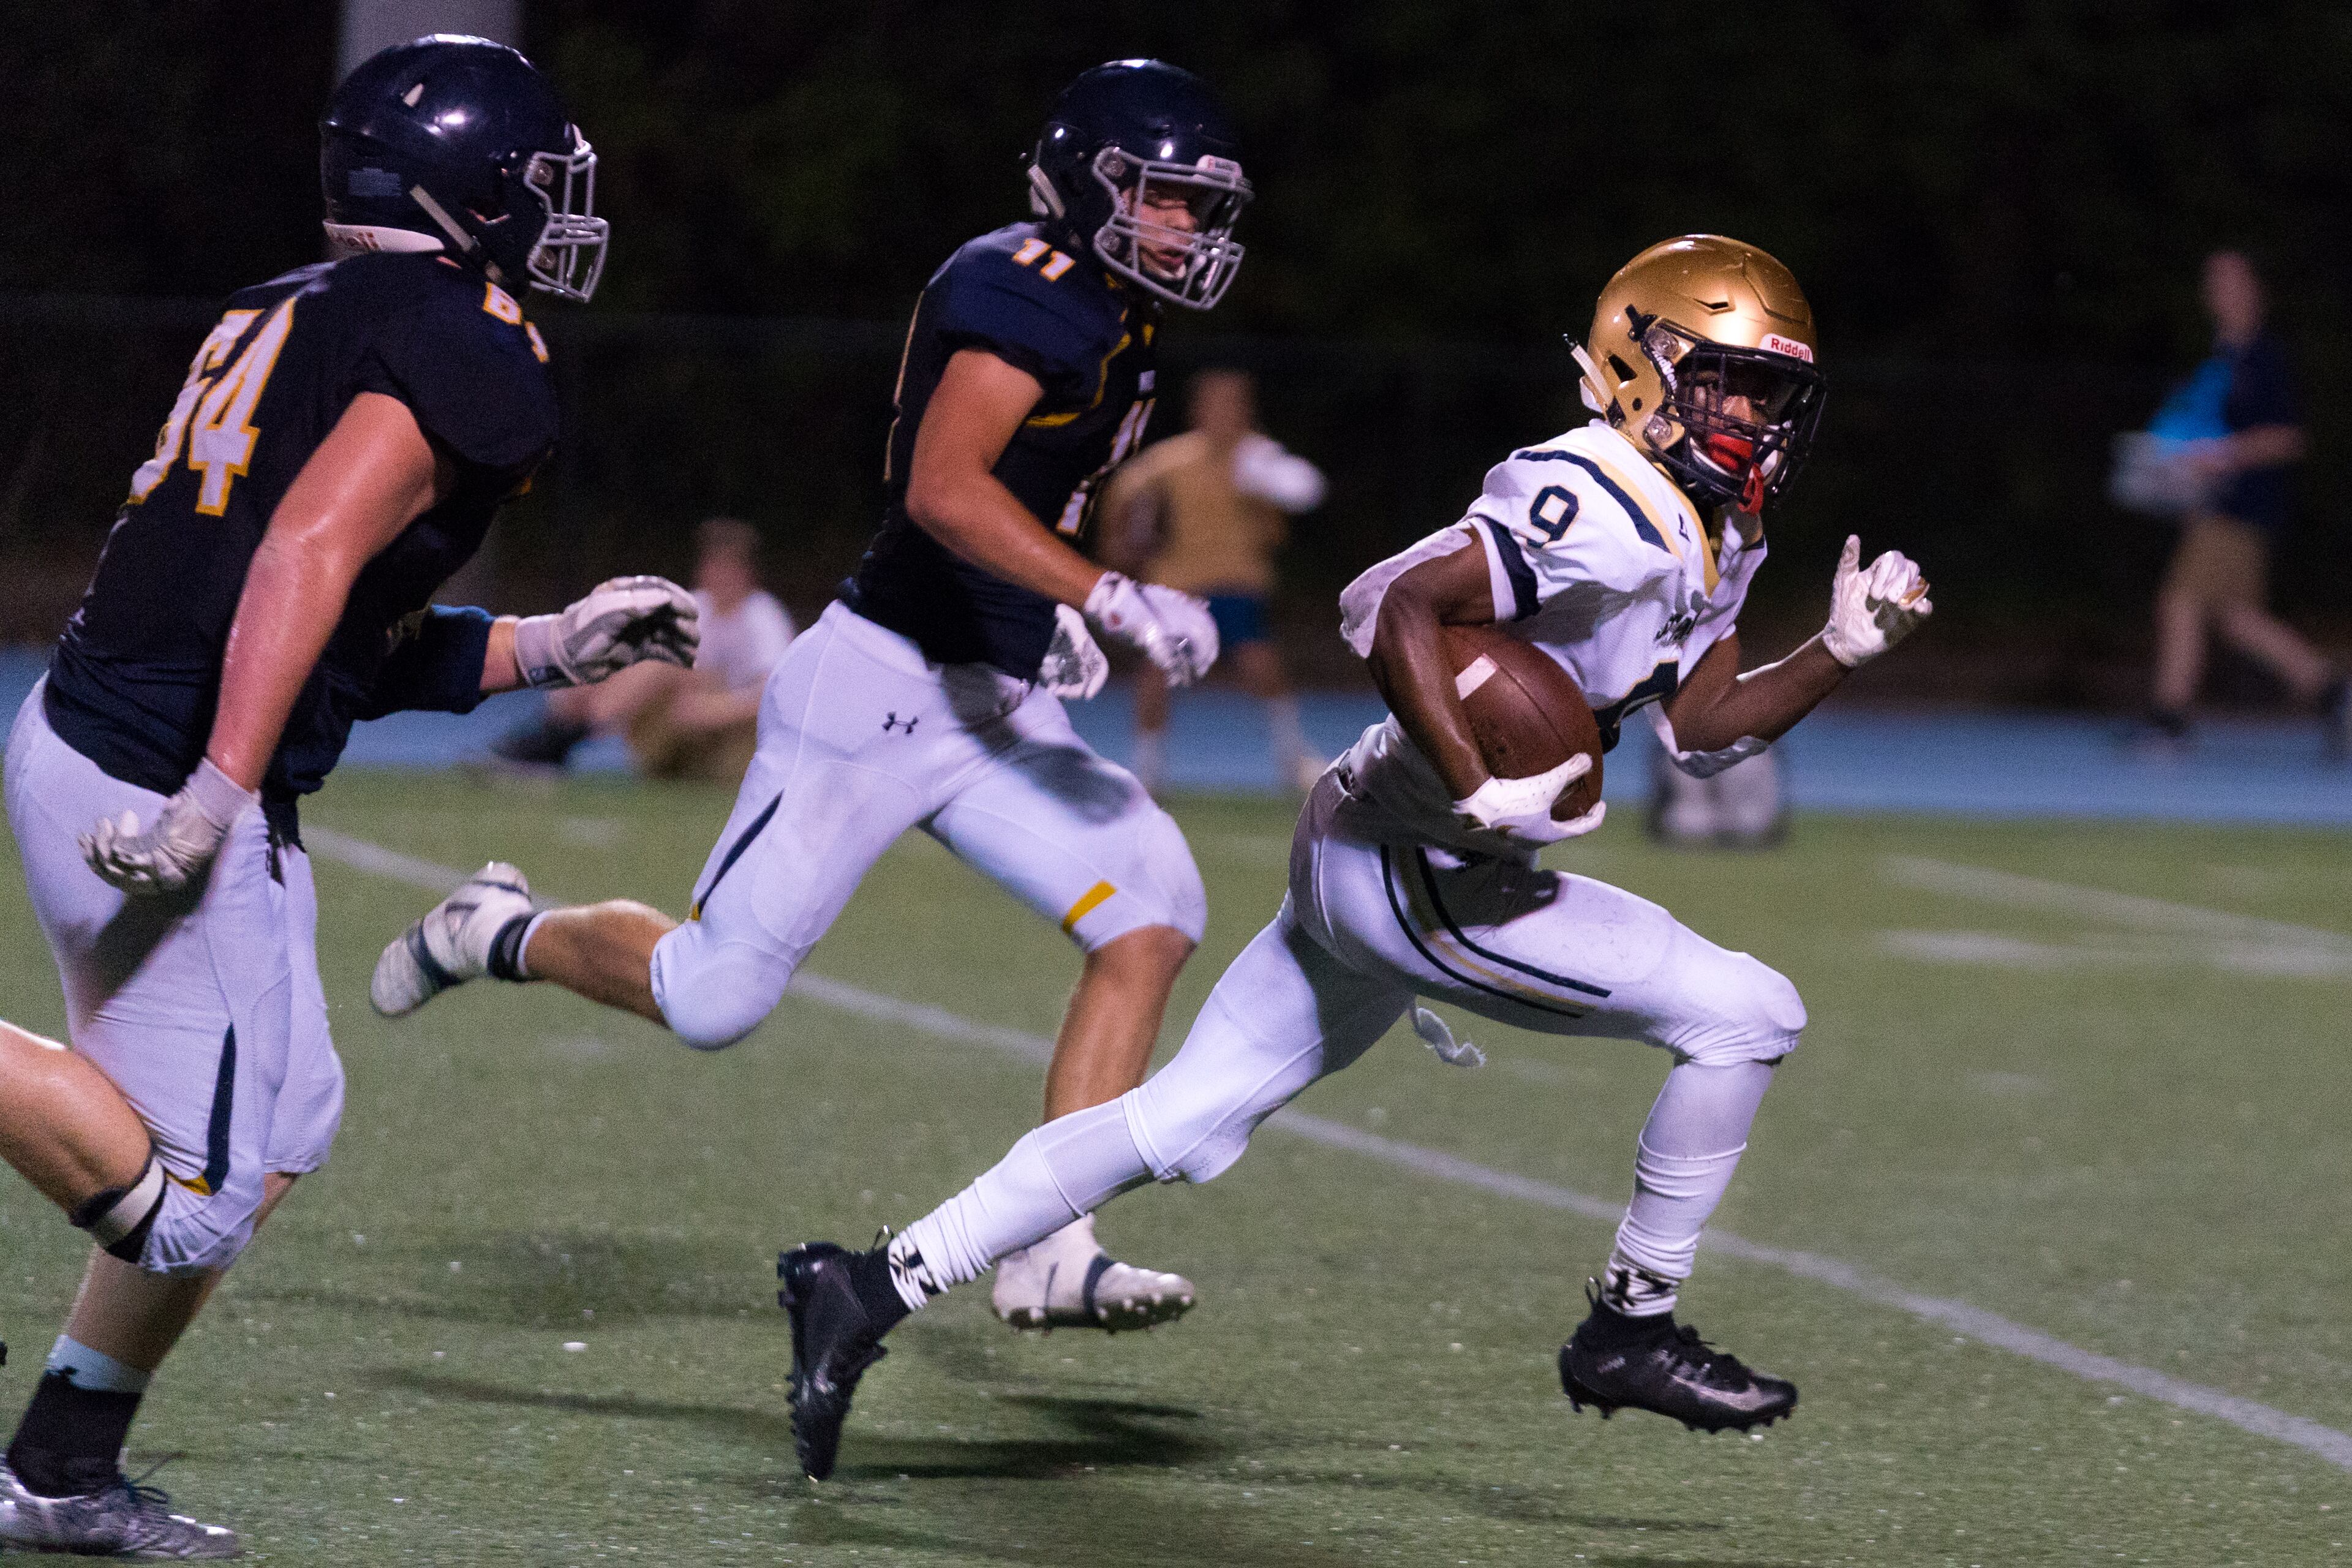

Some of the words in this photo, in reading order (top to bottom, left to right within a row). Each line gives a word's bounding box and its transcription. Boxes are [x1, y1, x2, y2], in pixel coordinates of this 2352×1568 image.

[1012, 237, 1076, 282] 11
[1771, 337, 1810, 361] Riddell
[1521, 484, 1580, 547] 9
